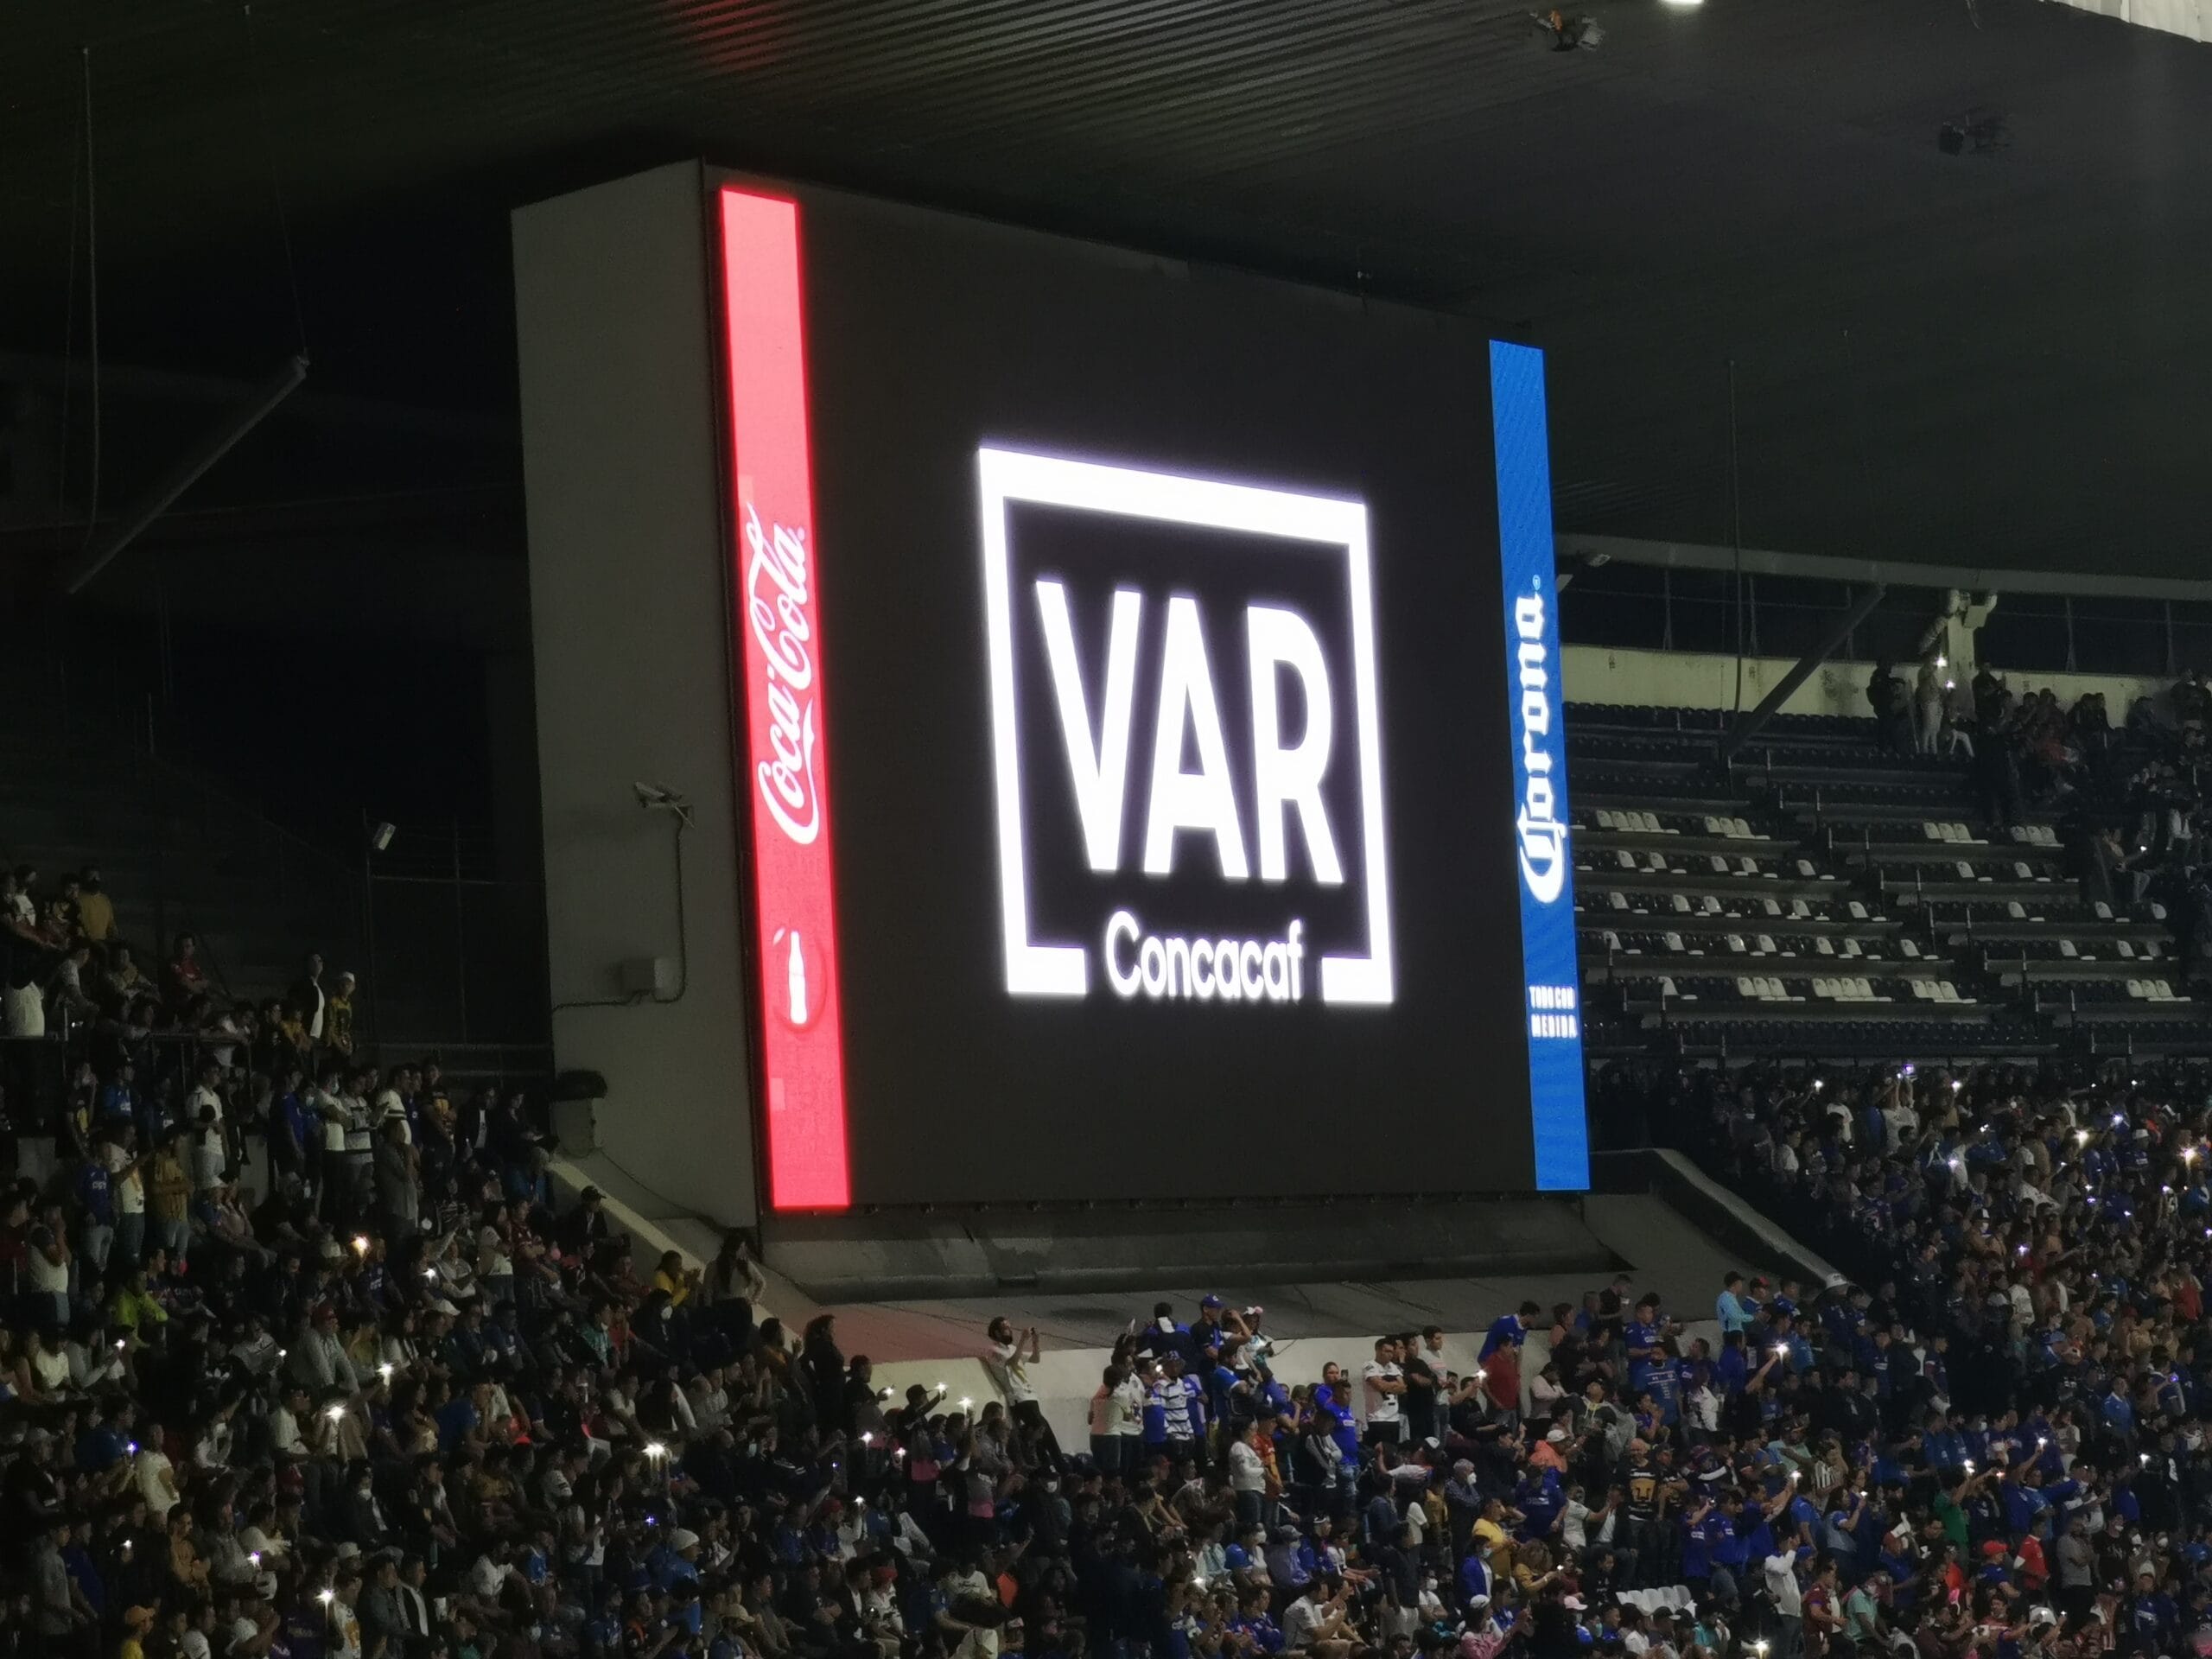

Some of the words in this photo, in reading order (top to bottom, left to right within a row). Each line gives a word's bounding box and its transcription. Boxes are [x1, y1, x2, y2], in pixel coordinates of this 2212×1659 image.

[746, 501, 819, 845] Coca-Cola
[1036, 580, 1344, 884] VAR
[1516, 593, 1567, 904] Corona
[1105, 910, 1304, 1001] Concacaf
